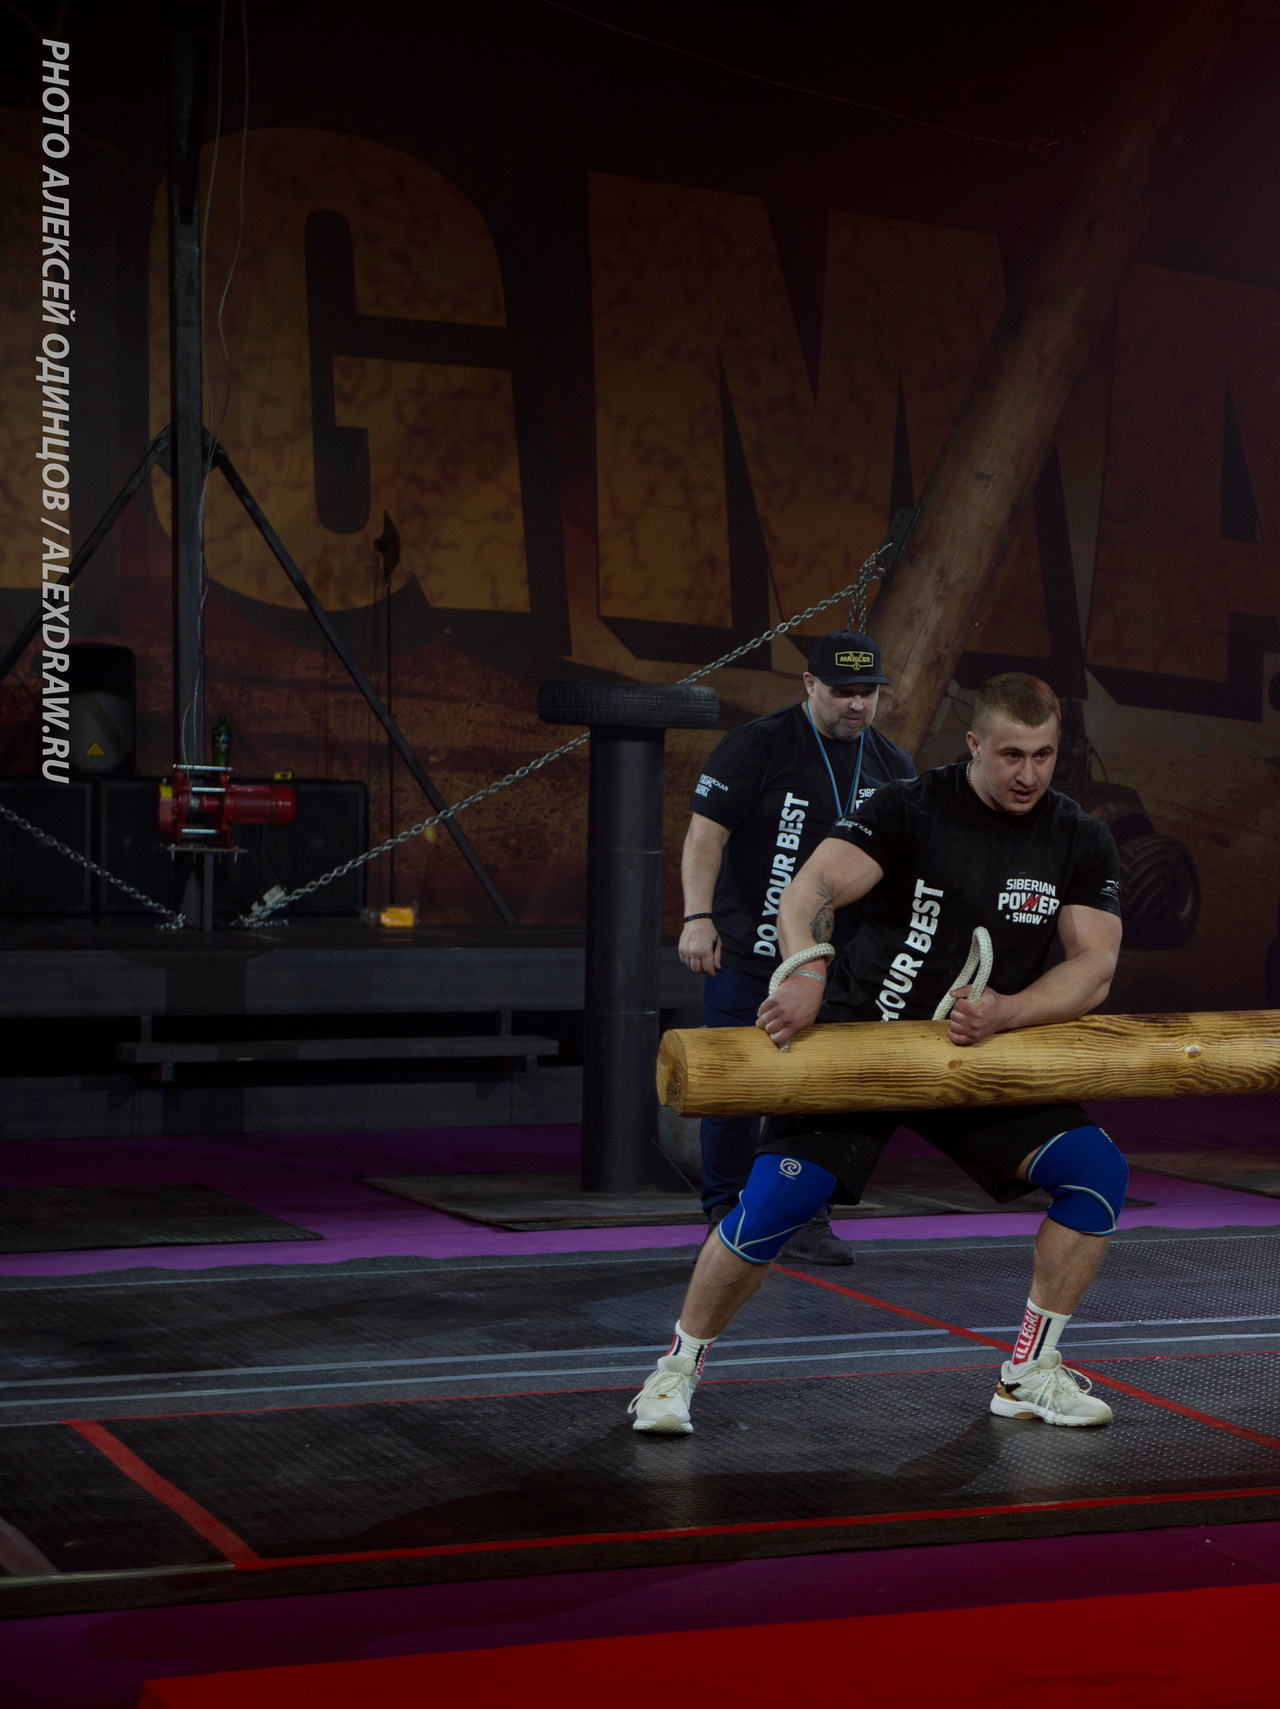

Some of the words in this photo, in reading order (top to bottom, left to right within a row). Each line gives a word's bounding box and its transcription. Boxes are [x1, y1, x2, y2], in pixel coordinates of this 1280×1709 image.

[775, 791, 810, 851] BEST
[761, 853, 797, 918] YOUR
[1005, 878, 1057, 898] SIBERIAN
[904, 878, 944, 954] BEST
[997, 892, 1061, 917] POWER
[1012, 911, 1044, 926] SHOW
[752, 922, 778, 958] DO
